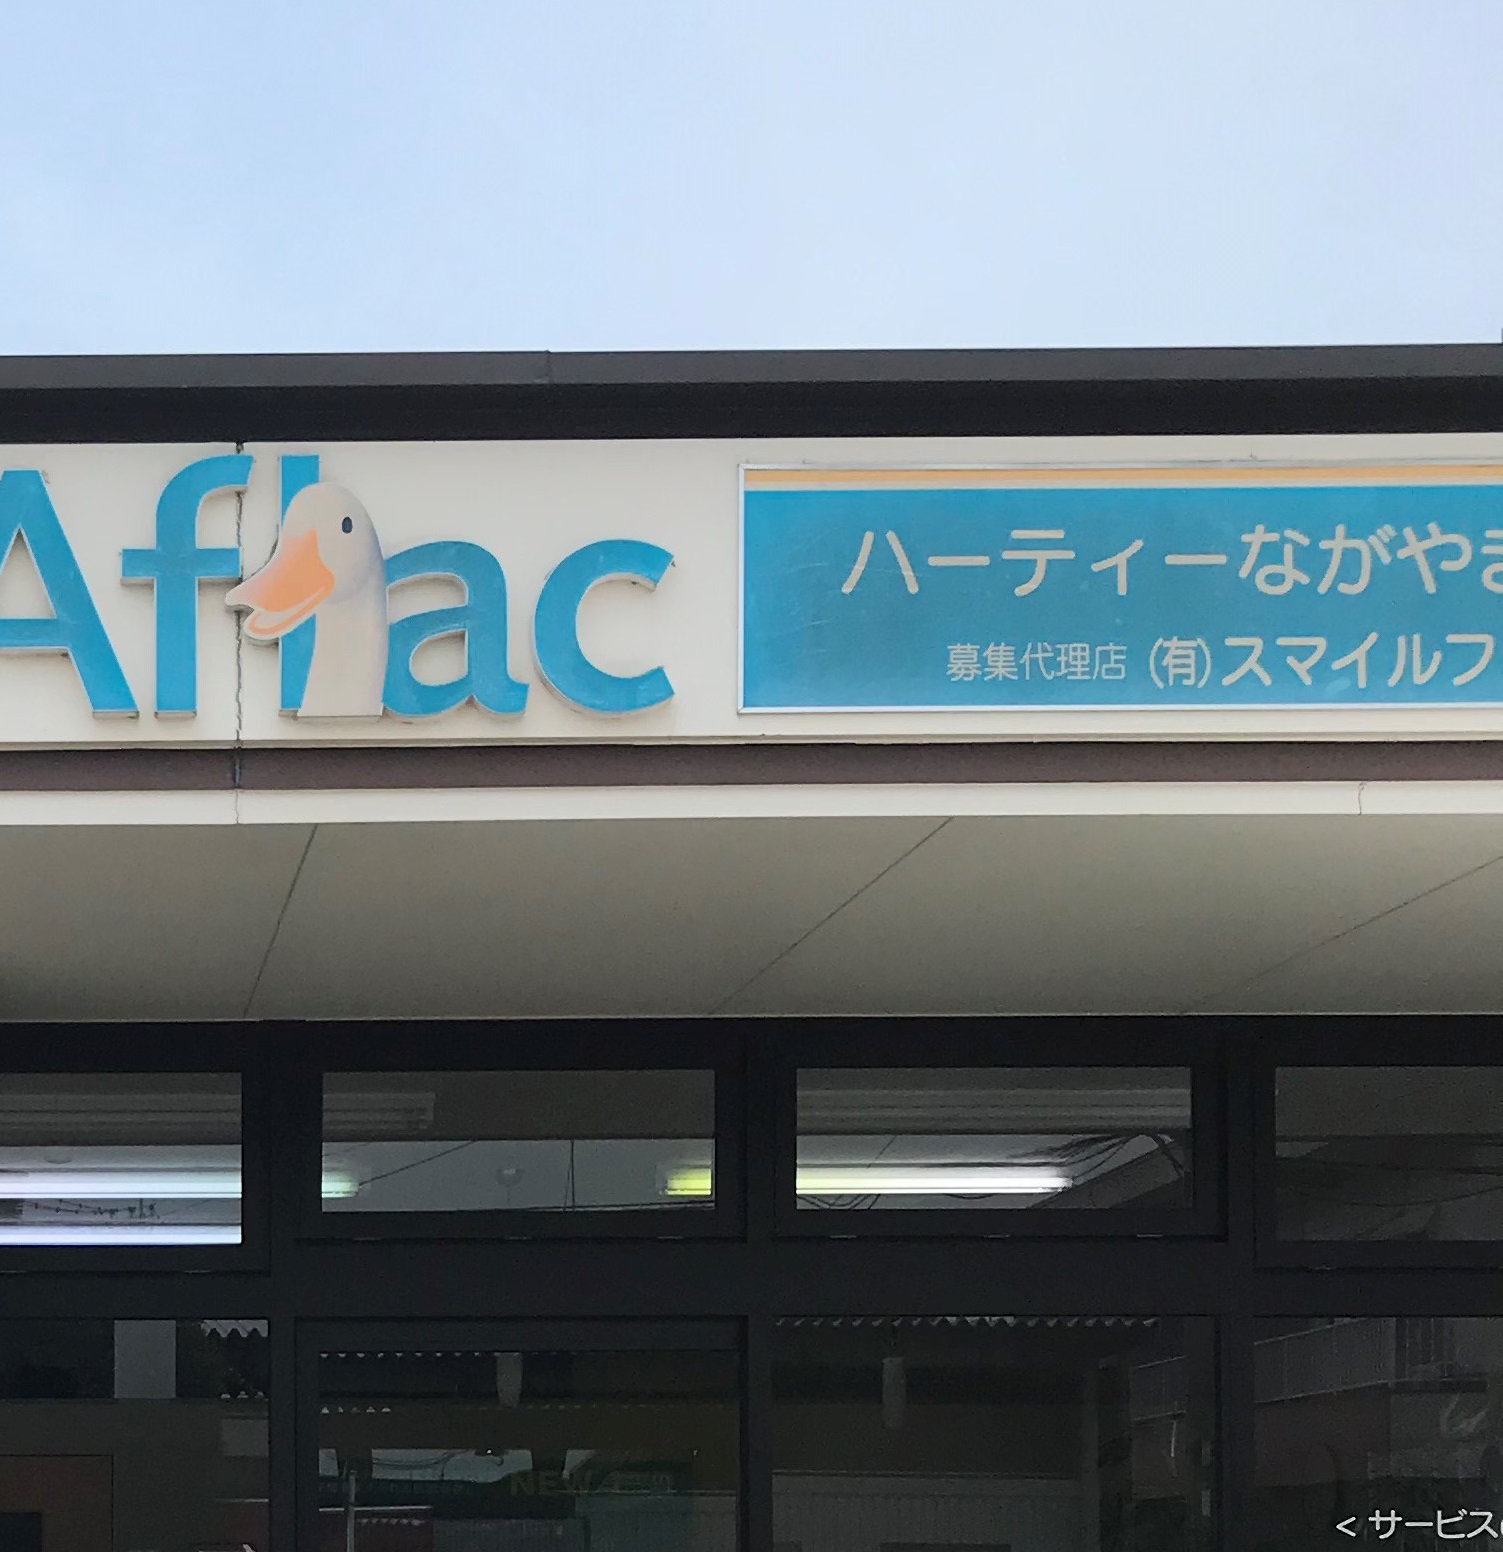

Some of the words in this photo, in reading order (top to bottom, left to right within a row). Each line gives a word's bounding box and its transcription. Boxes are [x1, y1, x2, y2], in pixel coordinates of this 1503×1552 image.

[945, 642, 1128, 682] 募集代理店
[1336, 1508, 1503, 1540] <サービス
